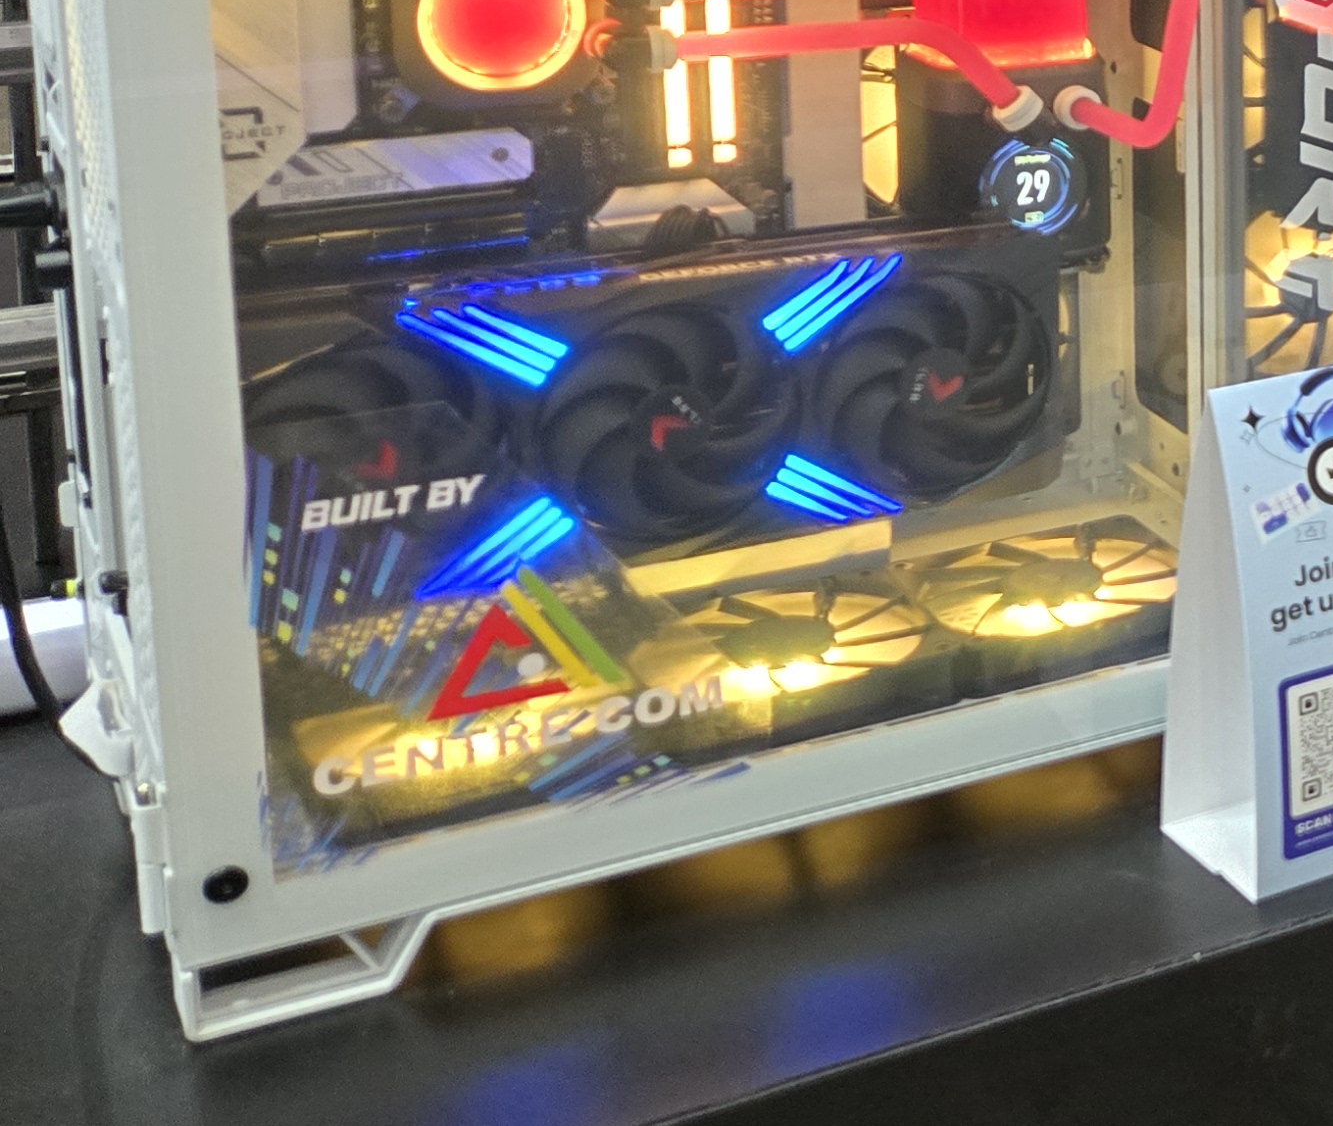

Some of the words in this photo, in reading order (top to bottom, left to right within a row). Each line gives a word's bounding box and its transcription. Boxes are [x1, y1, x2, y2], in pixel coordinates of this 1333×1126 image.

[1016, 169, 1051, 206] 29
[301, 481, 417, 532] BUILT
[425, 473, 486, 511] BY
[1270, 590, 1314, 633] get
[313, 707, 578, 797] CENTRE
[595, 675, 724, 733] COM
[1294, 810, 1333, 835] SCAN
